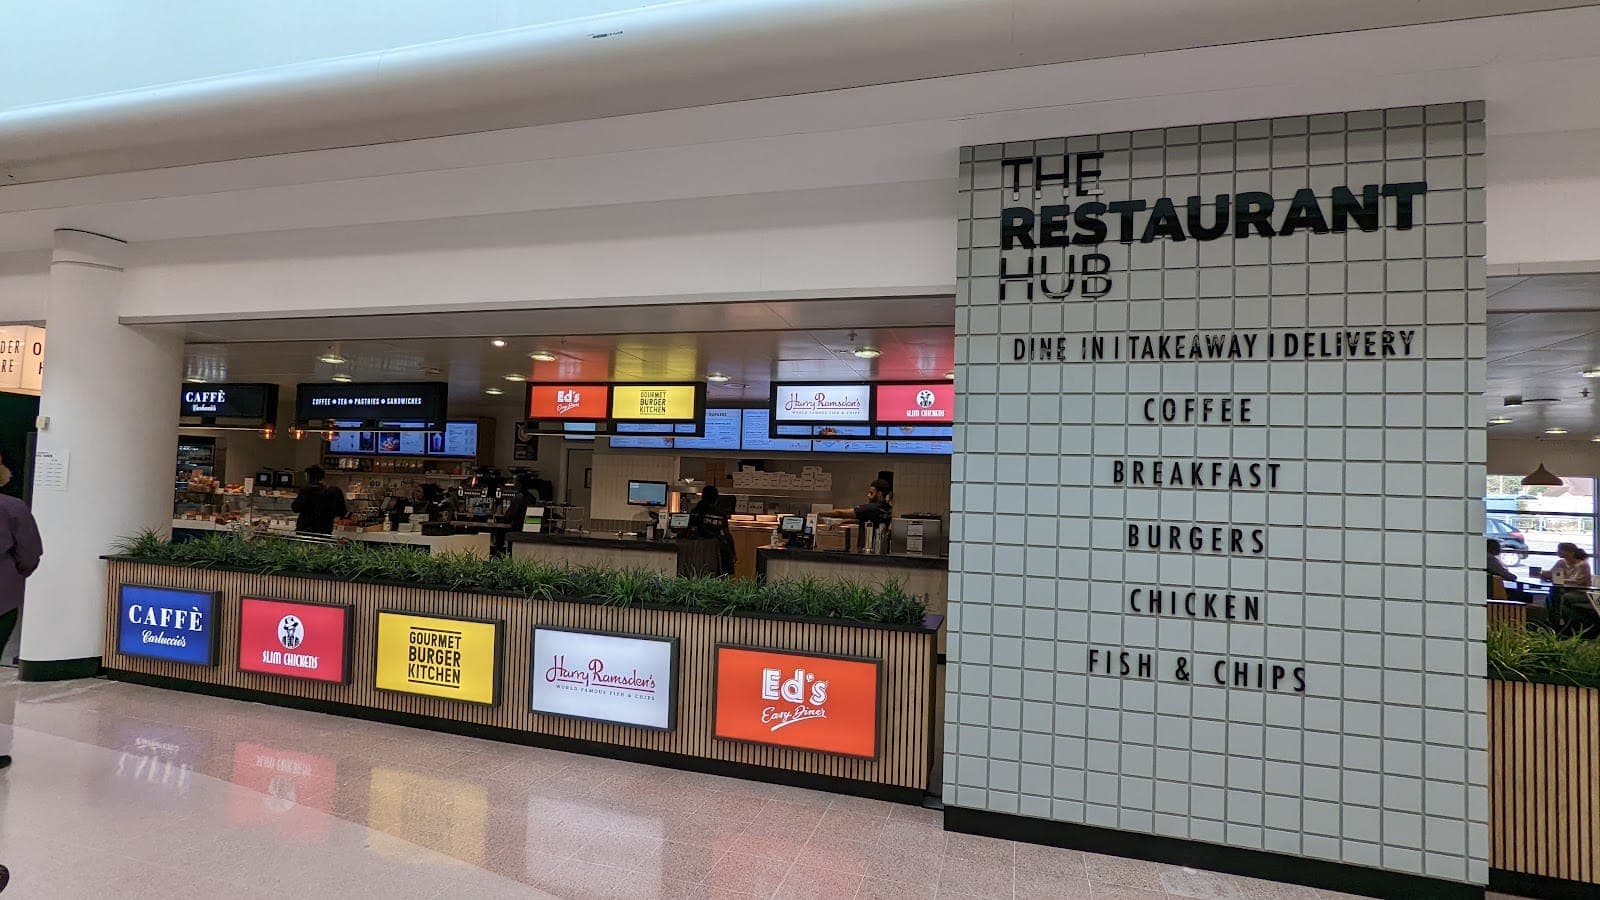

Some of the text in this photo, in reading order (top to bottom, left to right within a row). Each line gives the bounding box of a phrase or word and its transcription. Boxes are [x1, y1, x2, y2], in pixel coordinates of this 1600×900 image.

[1001, 152, 1105, 201] THE
[1001, 182, 1427, 250] RESTAURANT
[1000, 253, 1113, 300] HUB
[1013, 337, 1066, 360] DINE
[1082, 336, 1104, 360] IN
[1129, 334, 1258, 360] TAKEAWAY
[1284, 330, 1415, 357] DELIVERY
[185, 389, 226, 403] CAFFÈ
[640, 398, 666, 406] BURGER
[785, 392, 815, 410] Harry
[1144, 398, 1252, 423] COFFEE
[1113, 460, 1281, 488] BREAKFAST
[1128, 524, 1265, 554] BURGERS
[128, 604, 203, 632] CAFFÈ
[1130, 588, 1260, 621] CHICKEN
[142, 629, 187, 648] Carluccio's
[409, 631, 462, 649] GOURMET
[262, 650, 318, 670] SLIM CHICKENS
[409, 646, 461, 668] BURGER
[1089, 649, 1306, 692] FISH & CHIPS
[408, 663, 461, 684] KITCHEN
[545, 655, 656, 689] Harry Ramsden's
[762, 668, 828, 706] Ed's
[761, 705, 827, 723] Easy Diner
